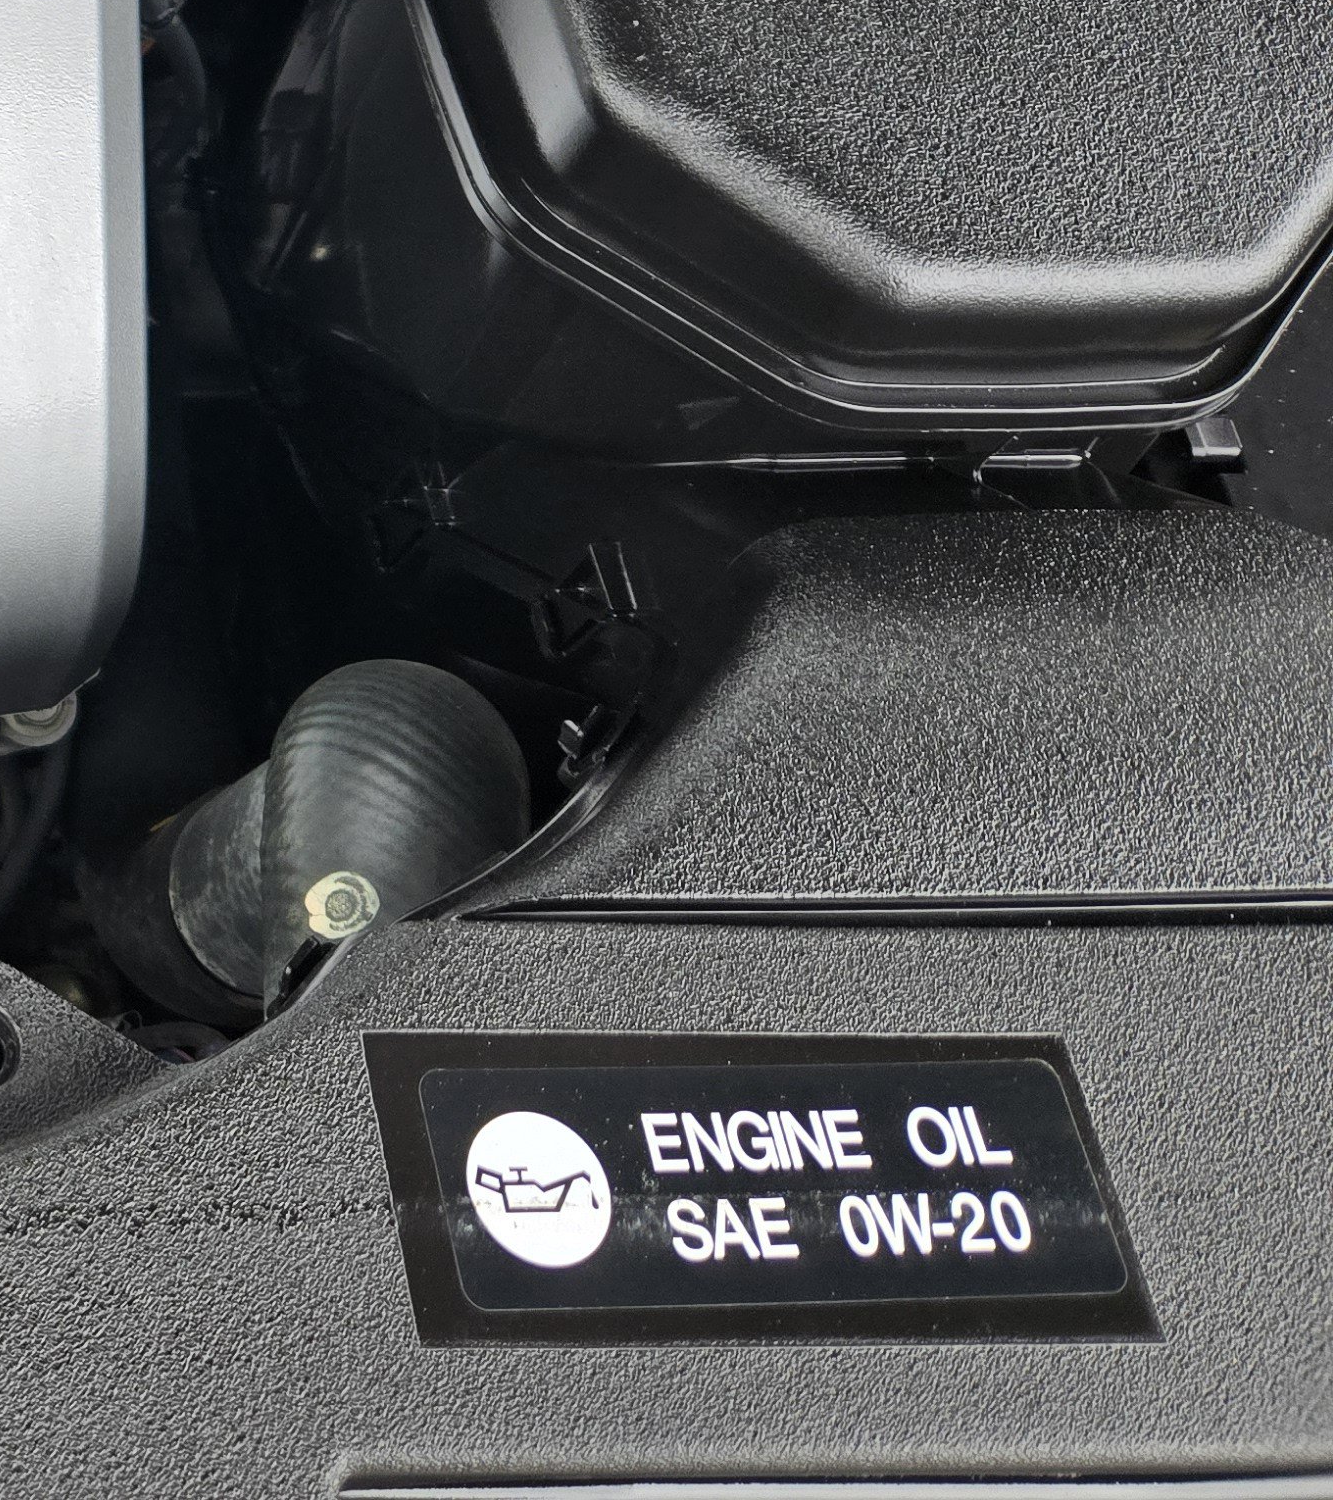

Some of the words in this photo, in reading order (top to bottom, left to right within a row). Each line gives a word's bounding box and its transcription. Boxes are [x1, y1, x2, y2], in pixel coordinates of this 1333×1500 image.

[641, 1108, 873, 1173] ENGINE
[906, 1105, 1014, 1168] OIL
[666, 1196, 801, 1262] SAE
[839, 1189, 1031, 1258] 0W-20
